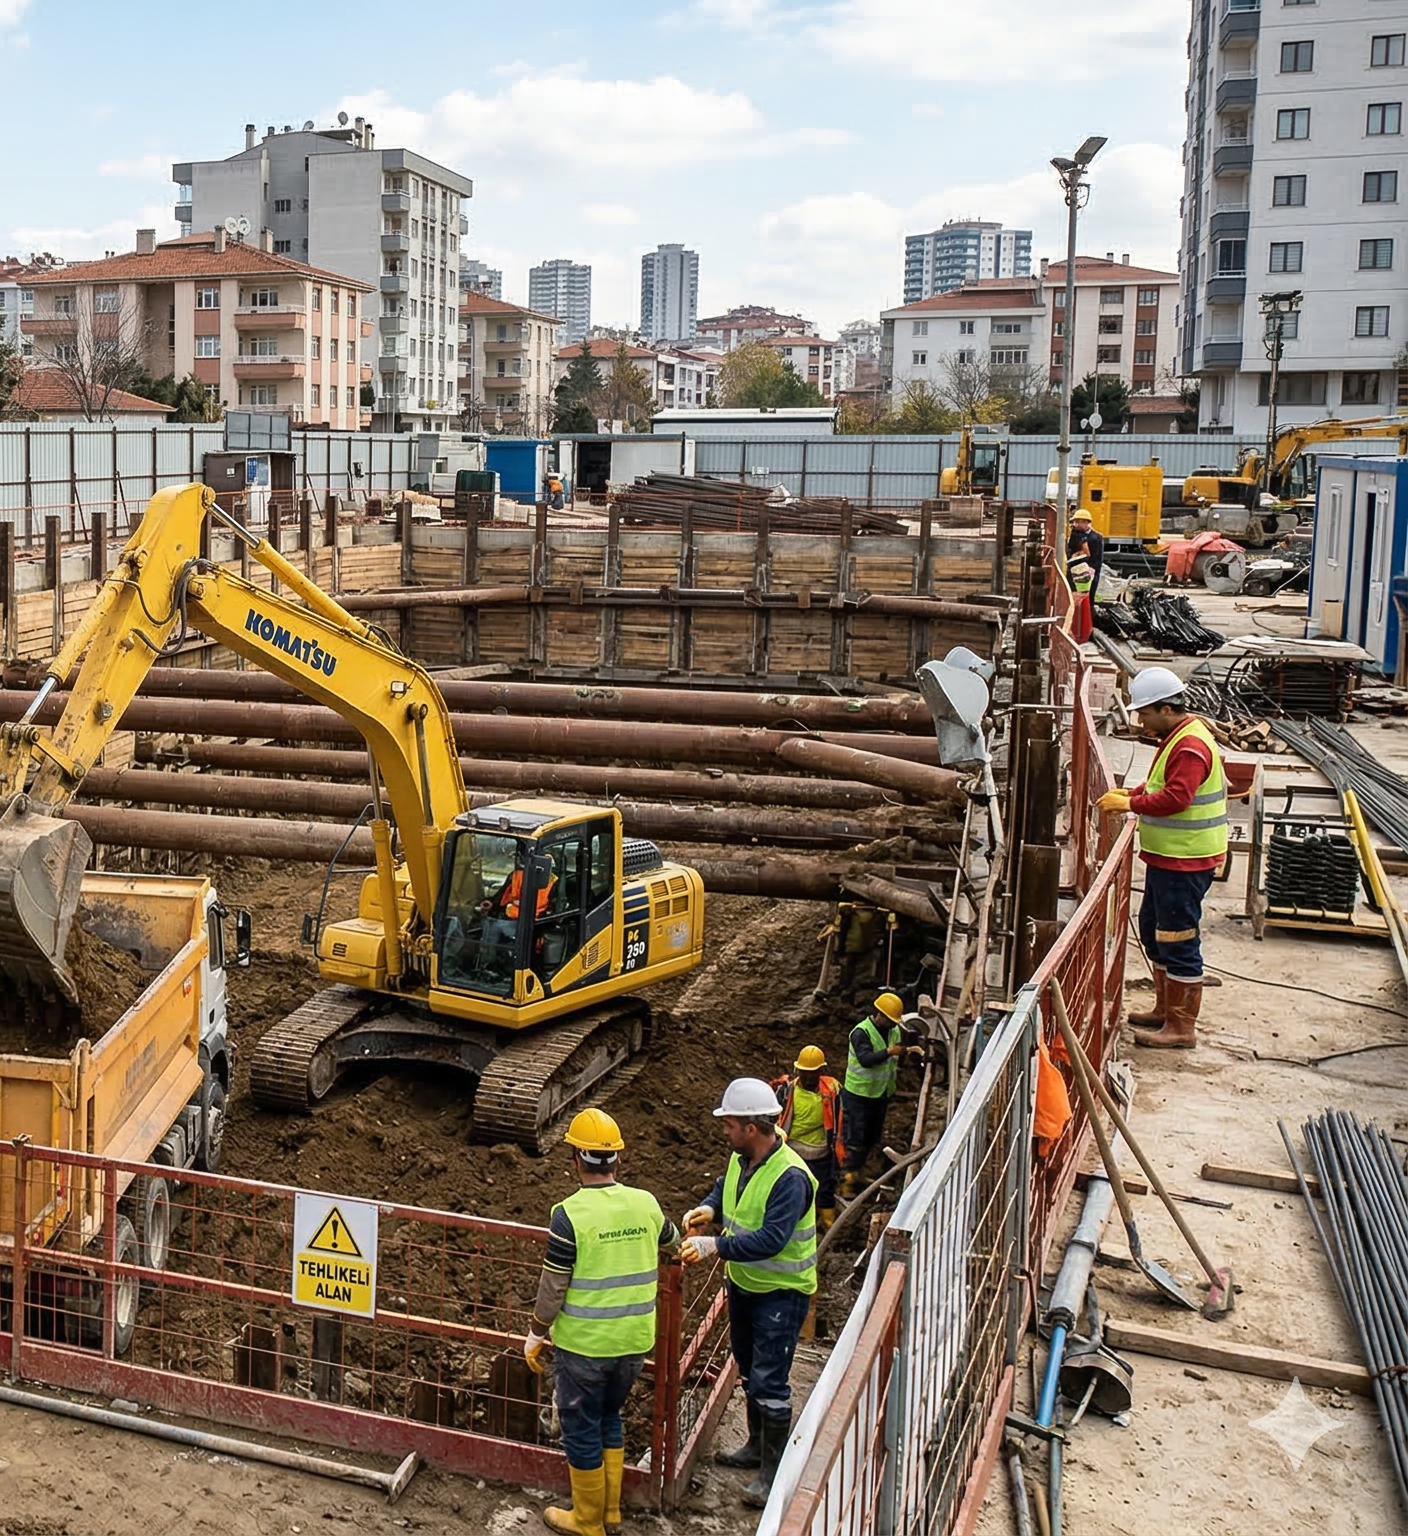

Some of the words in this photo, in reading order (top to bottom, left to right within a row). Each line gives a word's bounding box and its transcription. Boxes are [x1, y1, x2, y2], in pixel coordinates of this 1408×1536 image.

[244, 608, 337, 677] KOMATSU
[299, 1260, 370, 1287] TEHLİKELİ
[315, 1282, 352, 1303] ALAN
